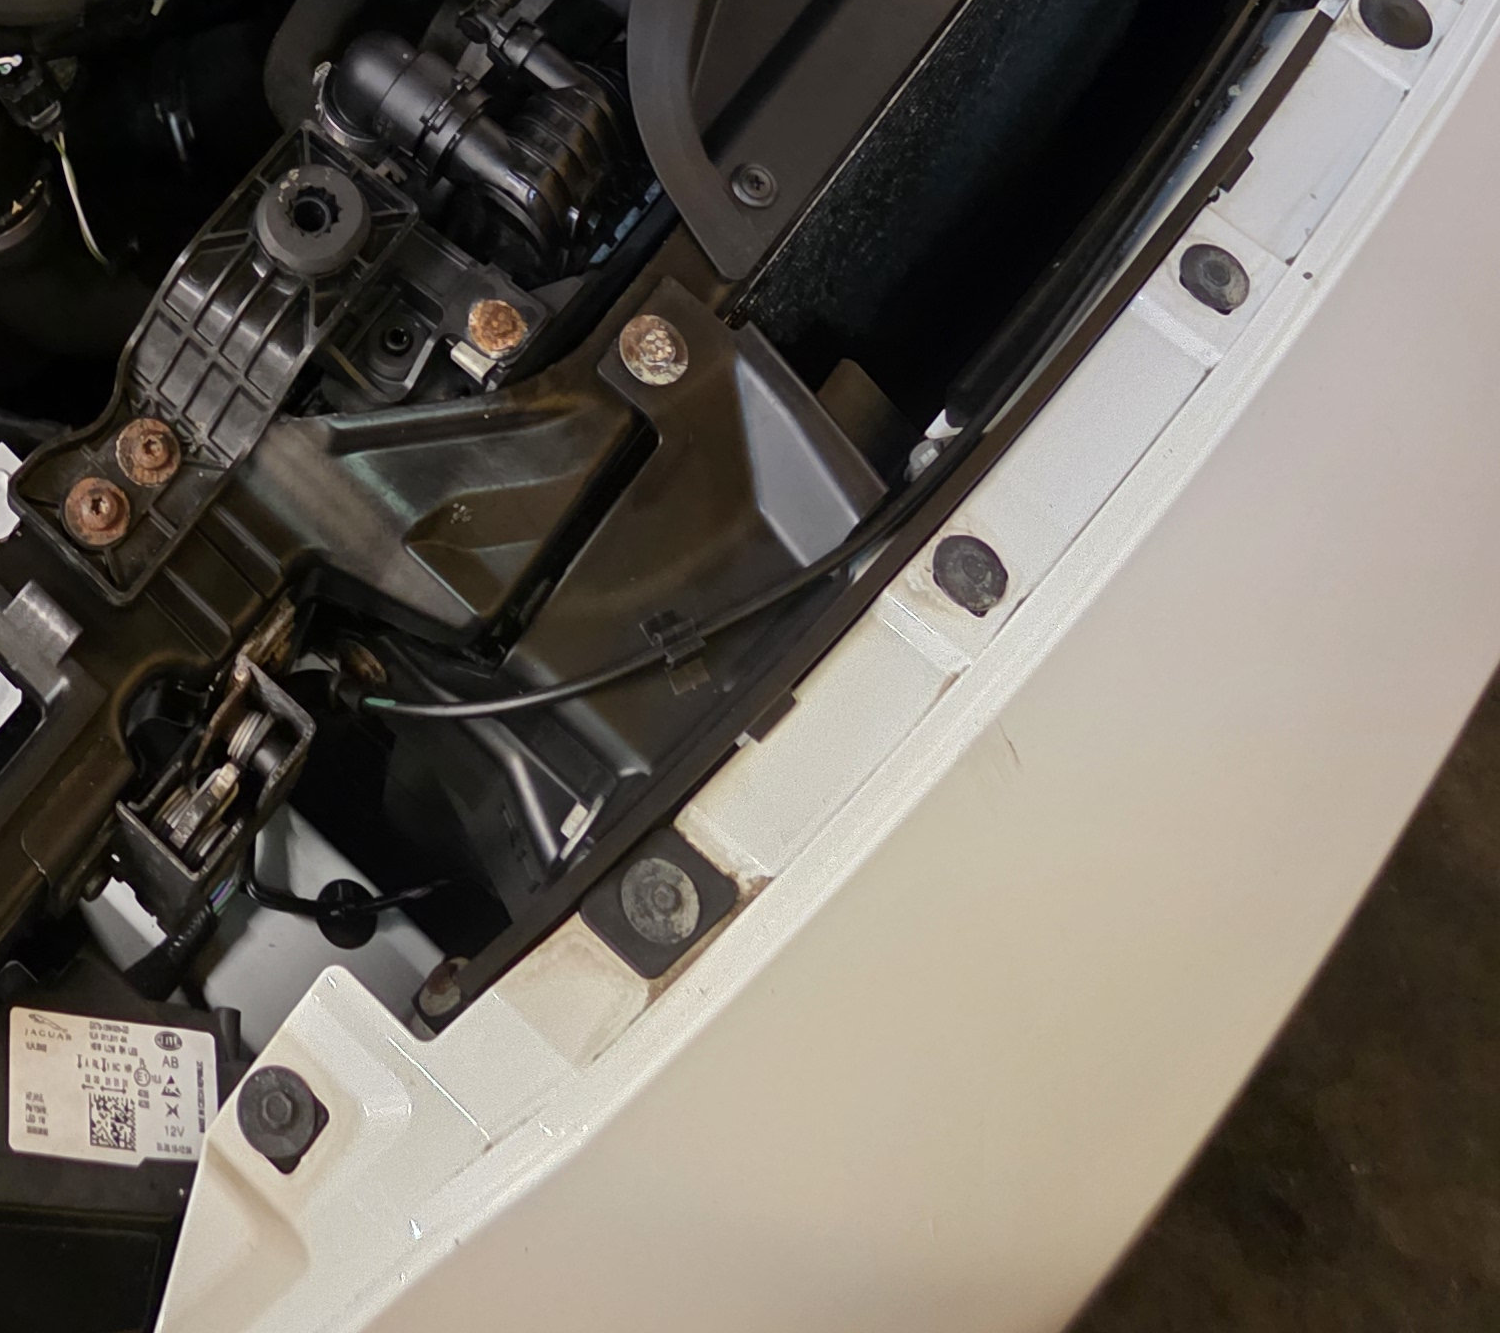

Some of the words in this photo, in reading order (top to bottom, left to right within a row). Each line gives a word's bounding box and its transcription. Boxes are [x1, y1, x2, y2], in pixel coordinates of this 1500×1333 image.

[24, 1028, 73, 1042] JAGUAR
[162, 1056, 180, 1070] AB
[164, 1124, 185, 1138] 12V
